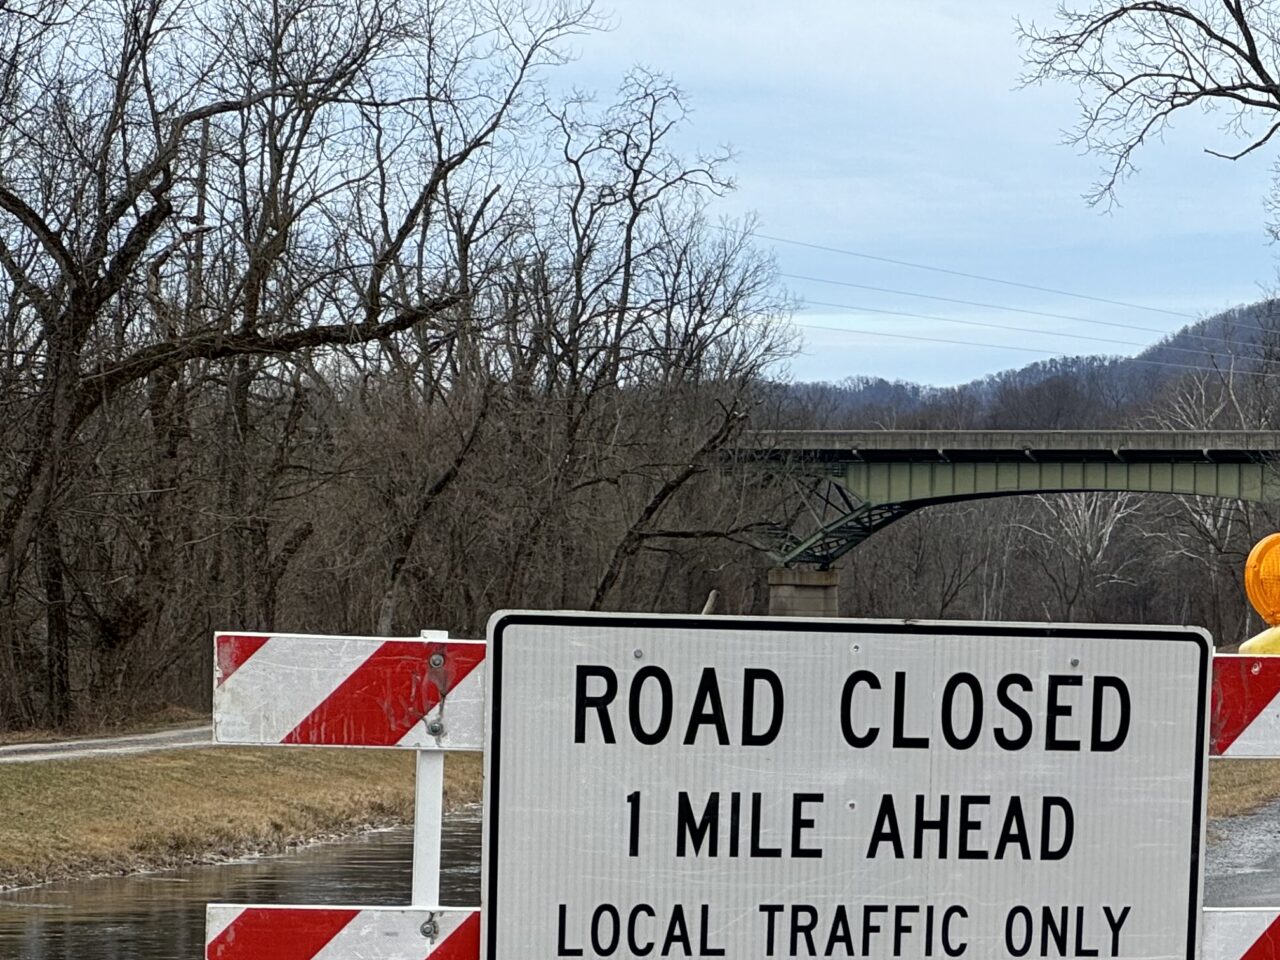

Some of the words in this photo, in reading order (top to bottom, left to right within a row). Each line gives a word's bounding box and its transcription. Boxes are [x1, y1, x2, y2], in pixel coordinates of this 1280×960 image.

[575, 665, 784, 747] ROAD
[841, 670, 1130, 752] CLOSED
[627, 791, 640, 857] 1
[676, 792, 824, 858] MILE
[867, 794, 1074, 860] AHEAD
[558, 904, 725, 957] LOCAL
[759, 904, 968, 957] TRAFFIC
[1006, 906, 1131, 957] ONLY
